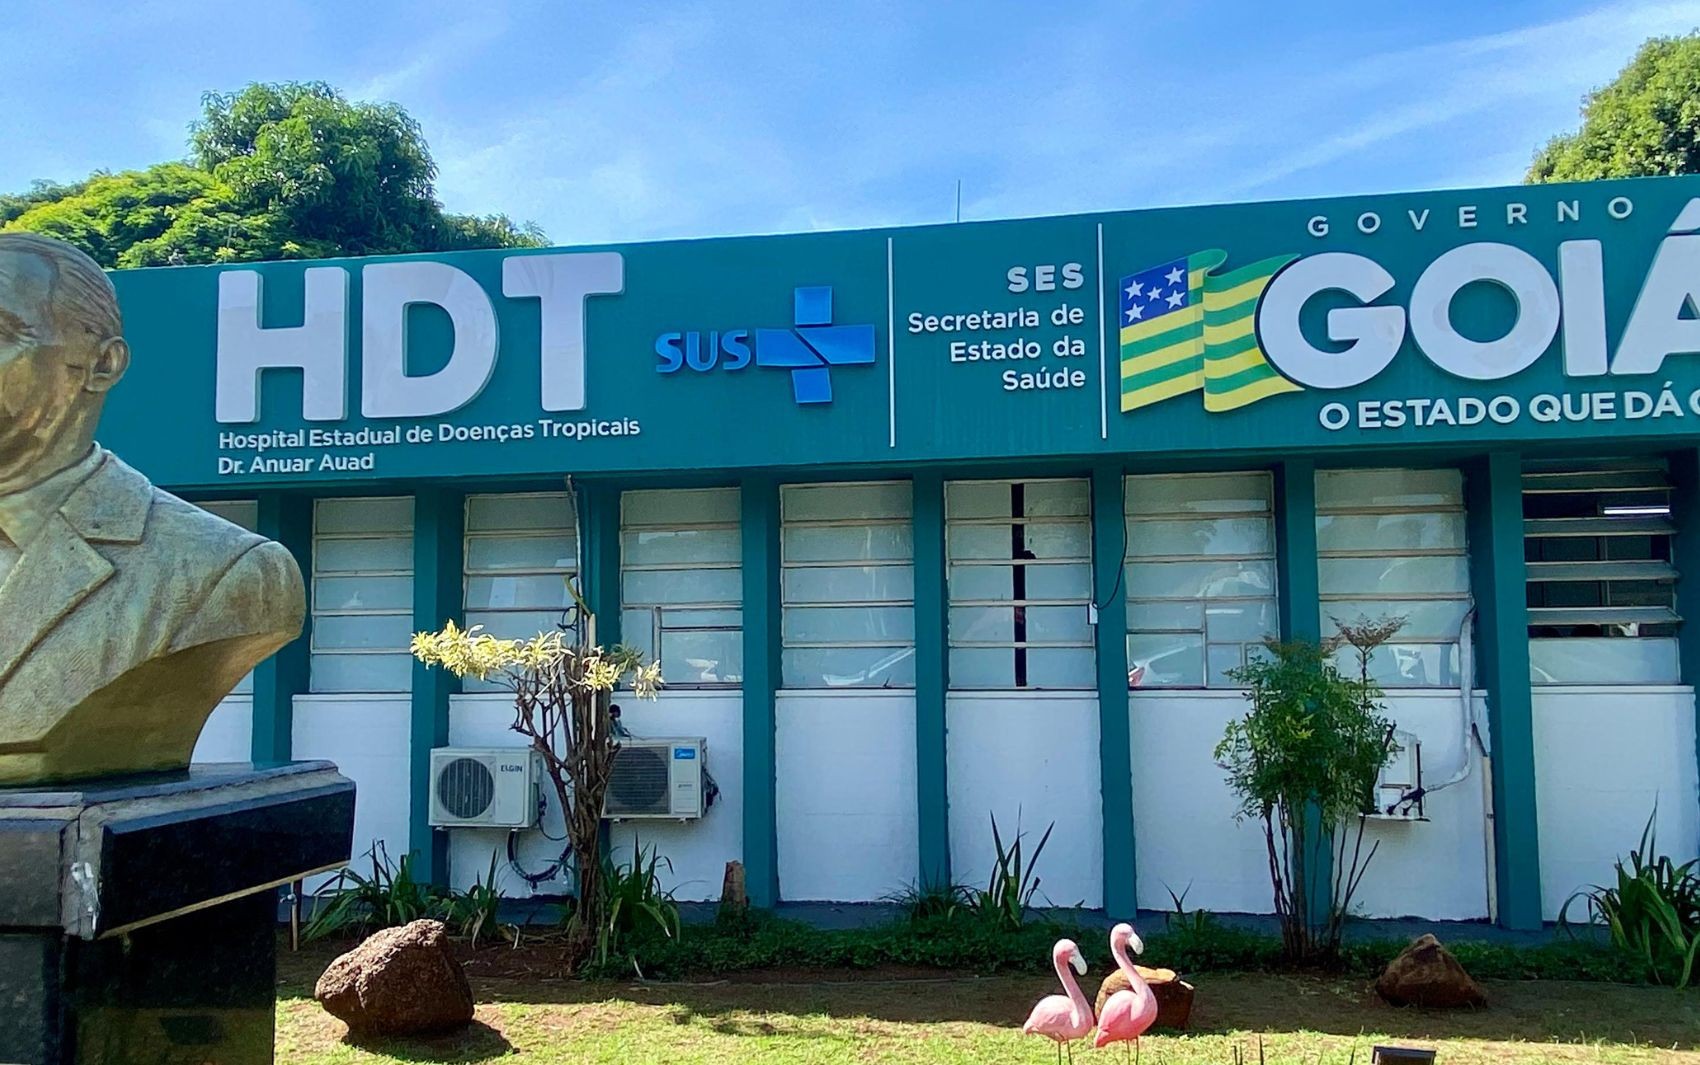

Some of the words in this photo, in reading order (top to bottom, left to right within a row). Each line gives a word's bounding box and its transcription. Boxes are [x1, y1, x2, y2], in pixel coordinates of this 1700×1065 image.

[1308, 196, 1633, 237] GOVERNO
[1007, 263, 1085, 293] SES
[1051, 304, 1085, 325] de
[216, 253, 625, 422] HDT
[655, 329, 751, 373] SUS
[950, 337, 1041, 363] Estado
[1053, 337, 1086, 357] da
[1003, 366, 1086, 390] Saúde
[1319, 402, 1351, 430] O
[1359, 395, 1520, 429] ESTADO
[1529, 392, 1617, 423] QUE
[1624, 381, 1684, 420] DÁ
[218, 429, 305, 452] Hospital
[309, 425, 401, 447] Estadual
[406, 424, 433, 444] de
[438, 420, 535, 444] Doenças
[541, 417, 641, 441] Tropicais
[218, 456, 246, 474] Dr.
[250, 455, 314, 473] Anuar
[318, 452, 374, 471] Auad
[500, 764, 523, 773] ELGIN
